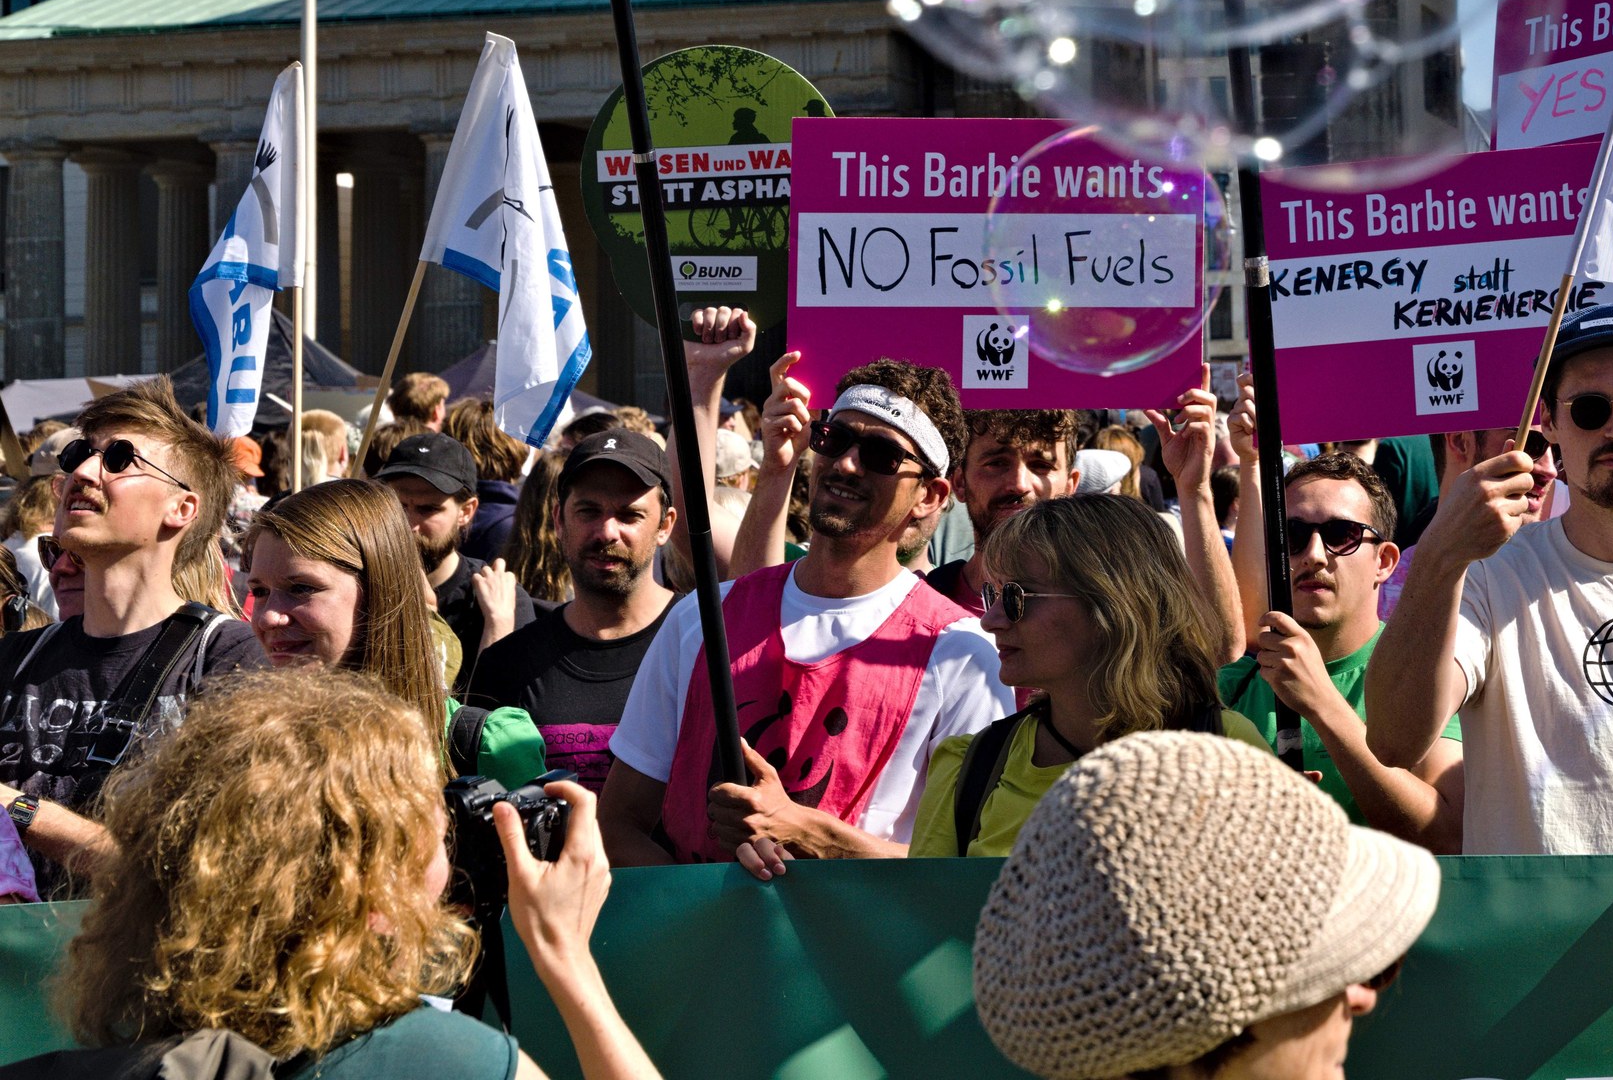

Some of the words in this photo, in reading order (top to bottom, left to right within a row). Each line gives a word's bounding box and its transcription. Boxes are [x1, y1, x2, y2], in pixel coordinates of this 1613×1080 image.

[1525, 13, 1583, 56] This
[1519, 68, 1607, 133] YES
[605, 152, 710, 177] WSEN
[713, 159, 746, 172] UND
[748, 149, 792, 171] WA
[832, 151, 910, 197] This
[923, 152, 1041, 198] Barbie
[1053, 159, 1164, 199] wants
[611, 182, 695, 206] STTT
[701, 178, 792, 201] ASPHA
[1280, 199, 1355, 244] This
[1366, 189, 1477, 237] Barbie
[698, 266, 743, 278] BUND
[817, 226, 910, 295] NO
[929, 226, 1039, 289] Fossil
[1064, 230, 1174, 286] Fuels
[1269, 257, 1428, 302] KENERGY
[1454, 258, 1515, 294] statt
[976, 369, 1015, 381] WWF
[1429, 392, 1465, 406] WWF
[0, 742, 89, 768] 201
